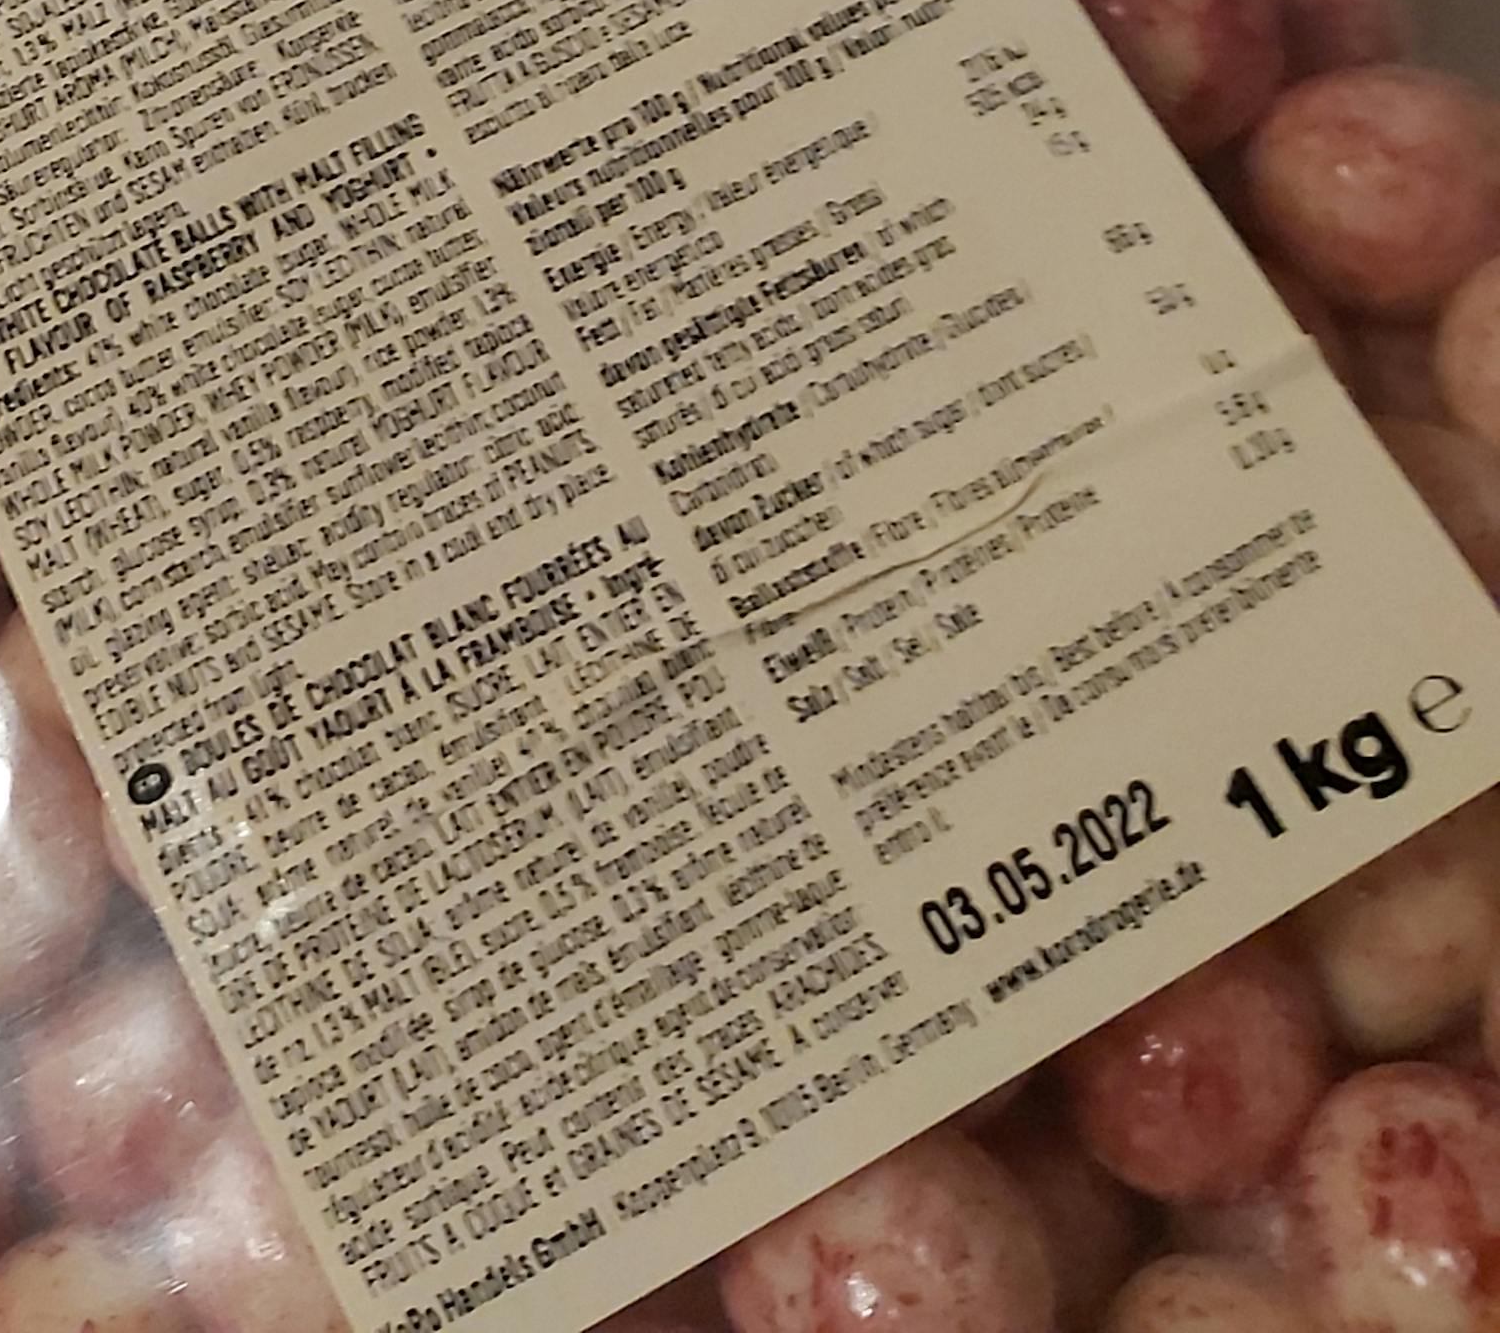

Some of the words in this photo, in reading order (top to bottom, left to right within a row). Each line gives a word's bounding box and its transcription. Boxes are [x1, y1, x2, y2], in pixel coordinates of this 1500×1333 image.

[2, 311, 97, 374] FLAVOUR
[102, 289, 132, 323] OF
[269, 202, 316, 243] AND
[50, 237, 172, 314] CHOCOLATE
[169, 205, 238, 256] BALLS
[290, 149, 347, 194] MALT
[302, 632, 417, 710] CHOCOLAT
[1223, 766, 1286, 839] 1
[1274, 711, 1412, 810] kg
[919, 780, 1170, 953] 03.05.2022
